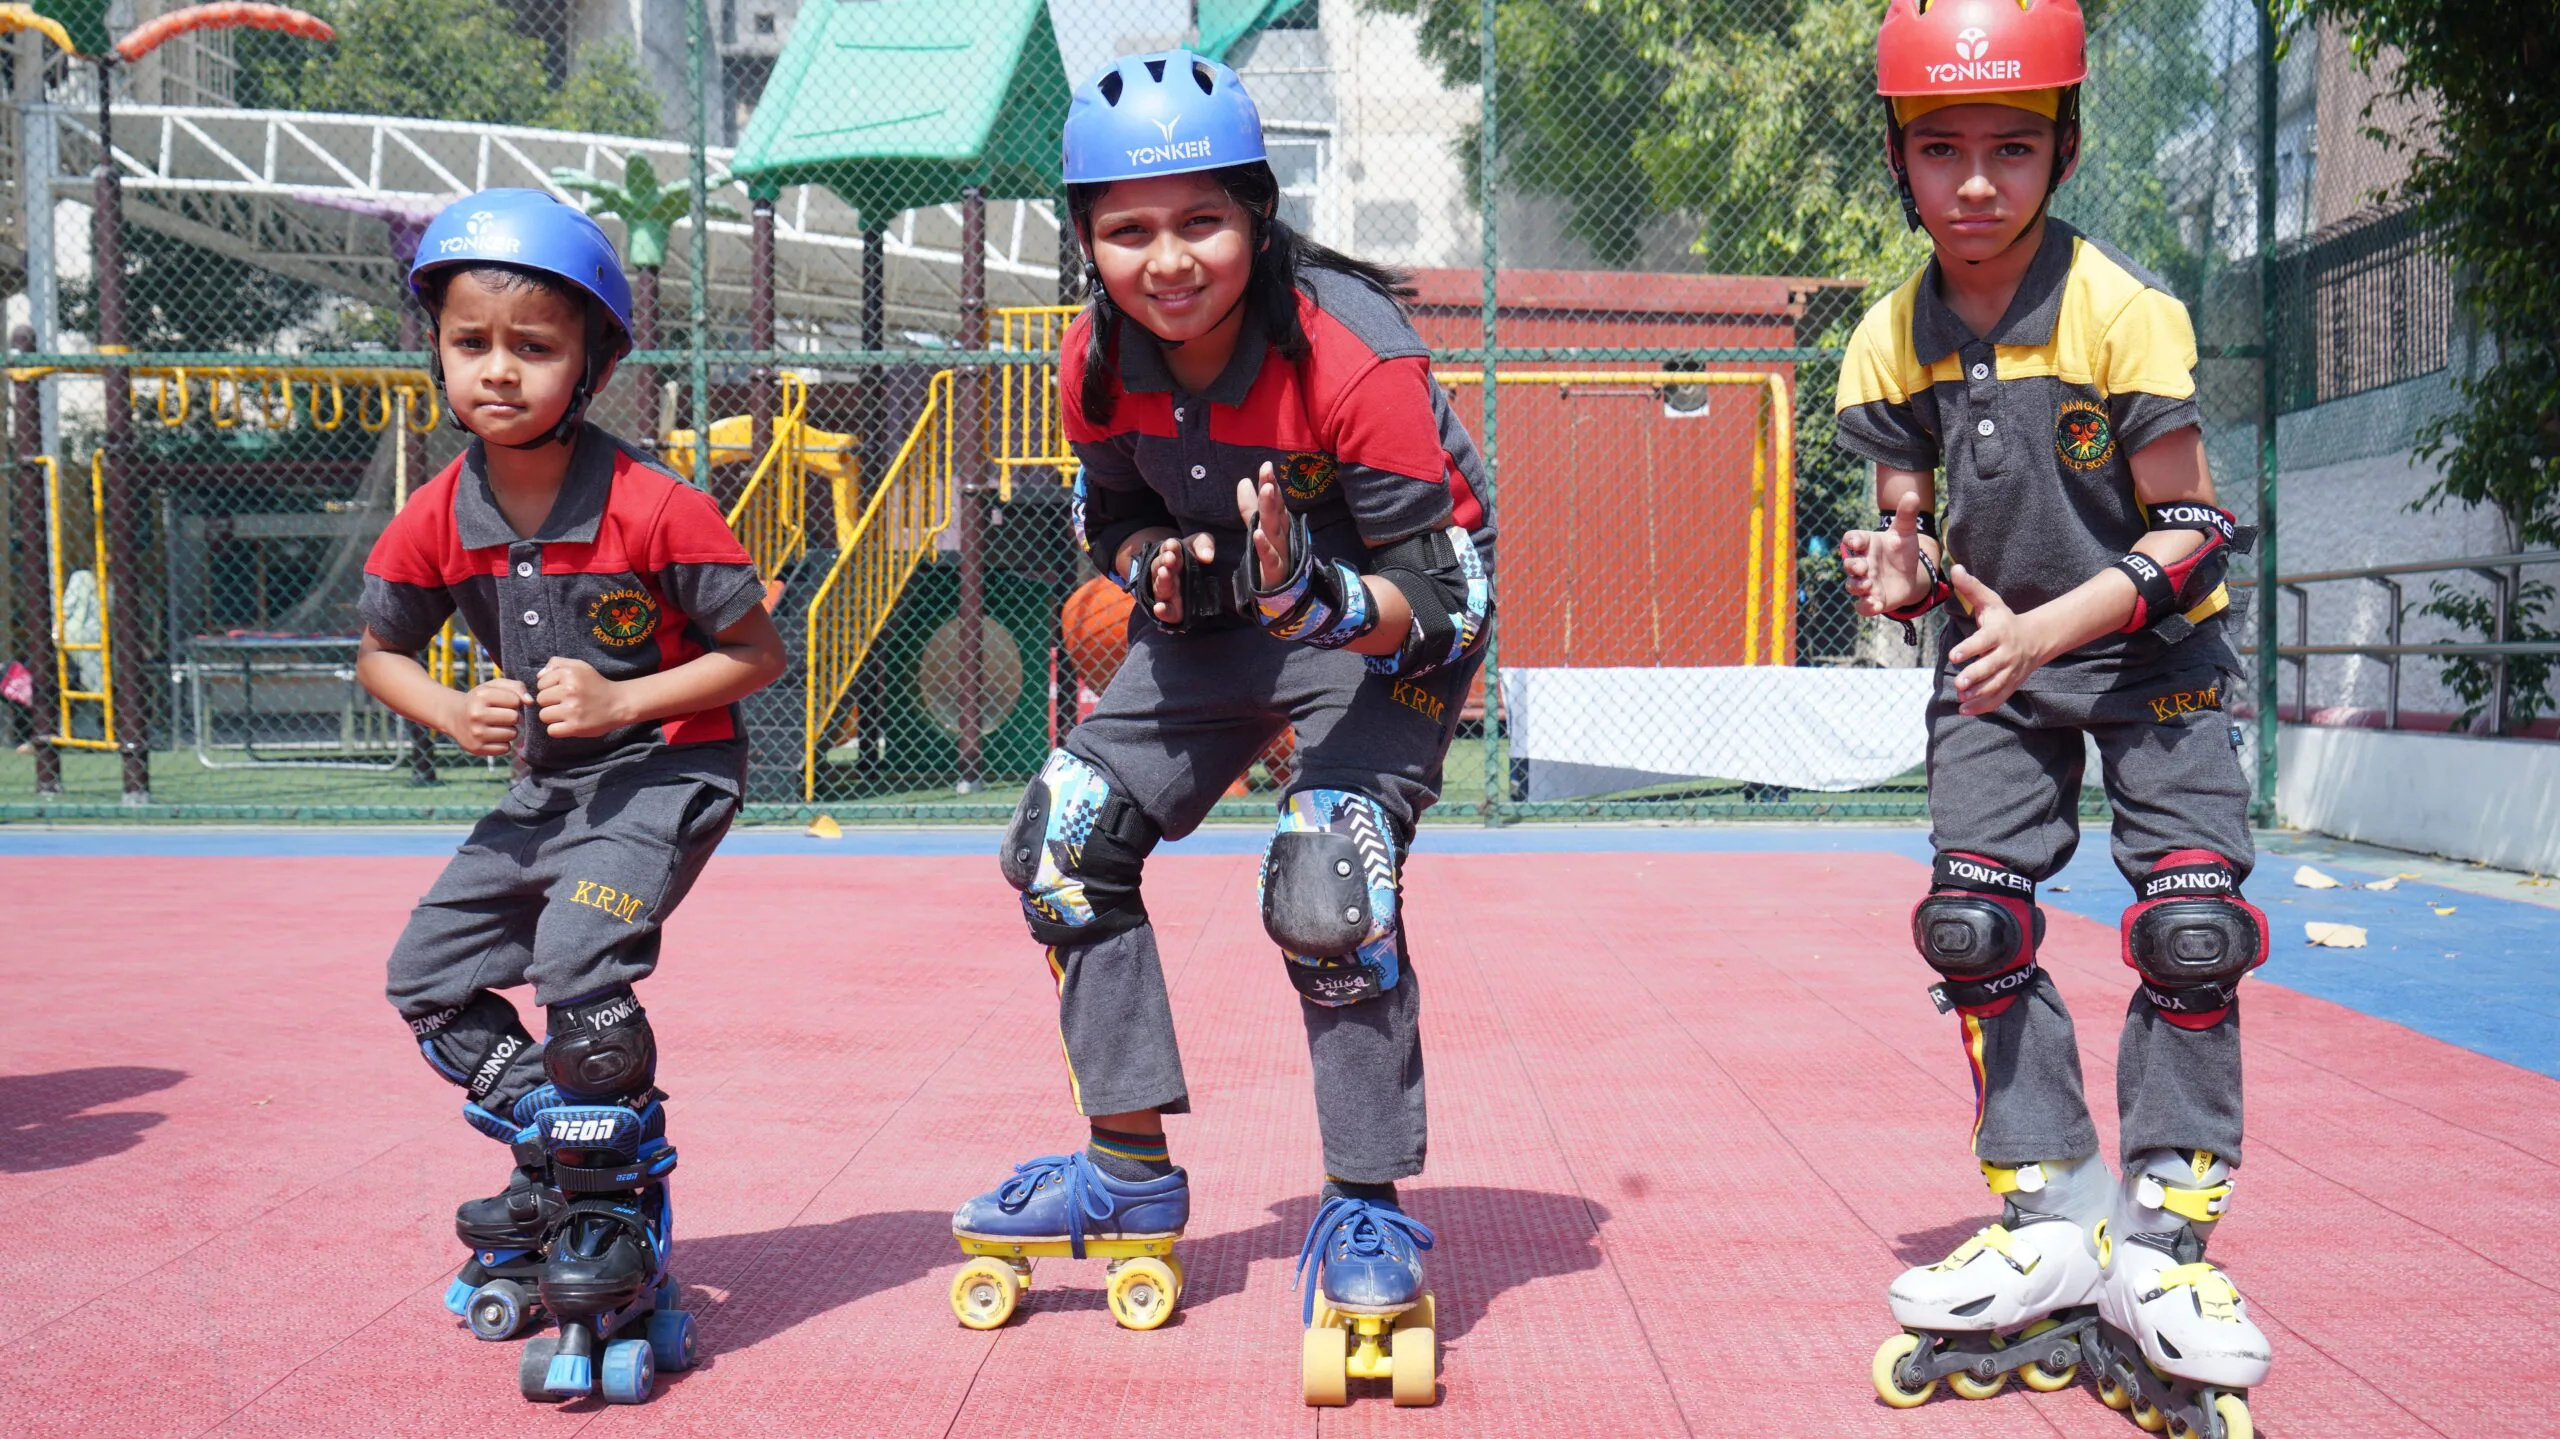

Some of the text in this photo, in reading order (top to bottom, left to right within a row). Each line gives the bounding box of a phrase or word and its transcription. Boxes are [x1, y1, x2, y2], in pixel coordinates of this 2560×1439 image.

[1925, 59, 2022, 84] YONKER
[1125, 139, 1212, 167] YONKER
[439, 235, 521, 255] YONKER
[2086, 440, 2116, 471] SCHOO
[2157, 507, 2235, 540] YONKE
[591, 616, 658, 647] WORLD SCHOOL
[1389, 680, 1446, 726] KRM
[2147, 687, 2220, 722] KRM
[1948, 860, 2032, 894] YONKER
[569, 880, 644, 925] KRM
